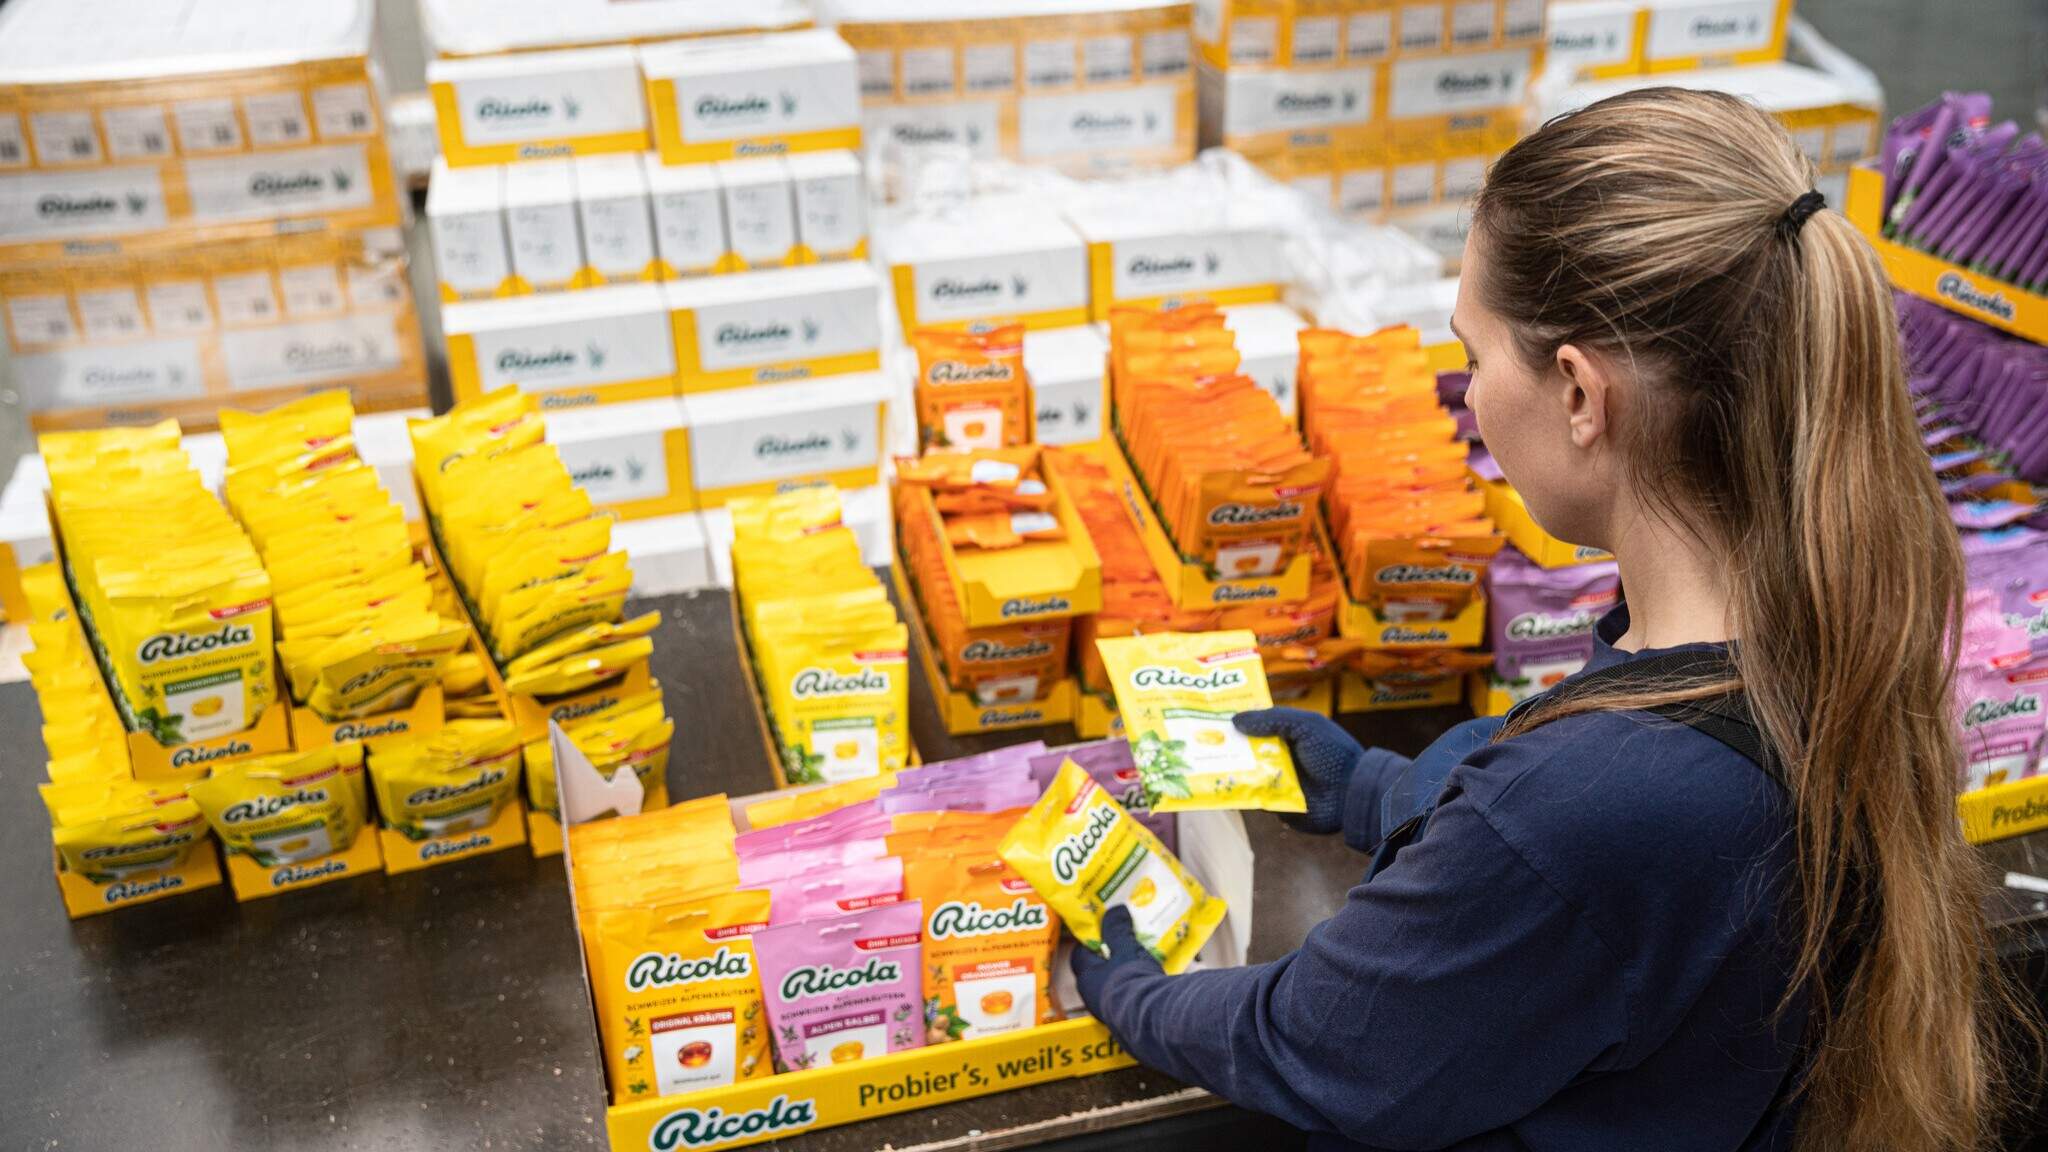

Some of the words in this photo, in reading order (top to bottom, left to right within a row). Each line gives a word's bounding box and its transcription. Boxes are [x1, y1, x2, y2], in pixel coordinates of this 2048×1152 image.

[141, 624, 252, 664] Ricola
[795, 669, 885, 696] Ricola
[1135, 667, 1240, 690] Ricola
[1055, 805, 1118, 881] Ricola
[932, 901, 1043, 936] Ricola
[629, 949, 747, 989] Ricola
[783, 959, 898, 1001] Ricola
[859, 1062, 989, 1106] Probier's,
[996, 1045, 1072, 1079] weil's
[654, 1097, 813, 1150] Ricola
